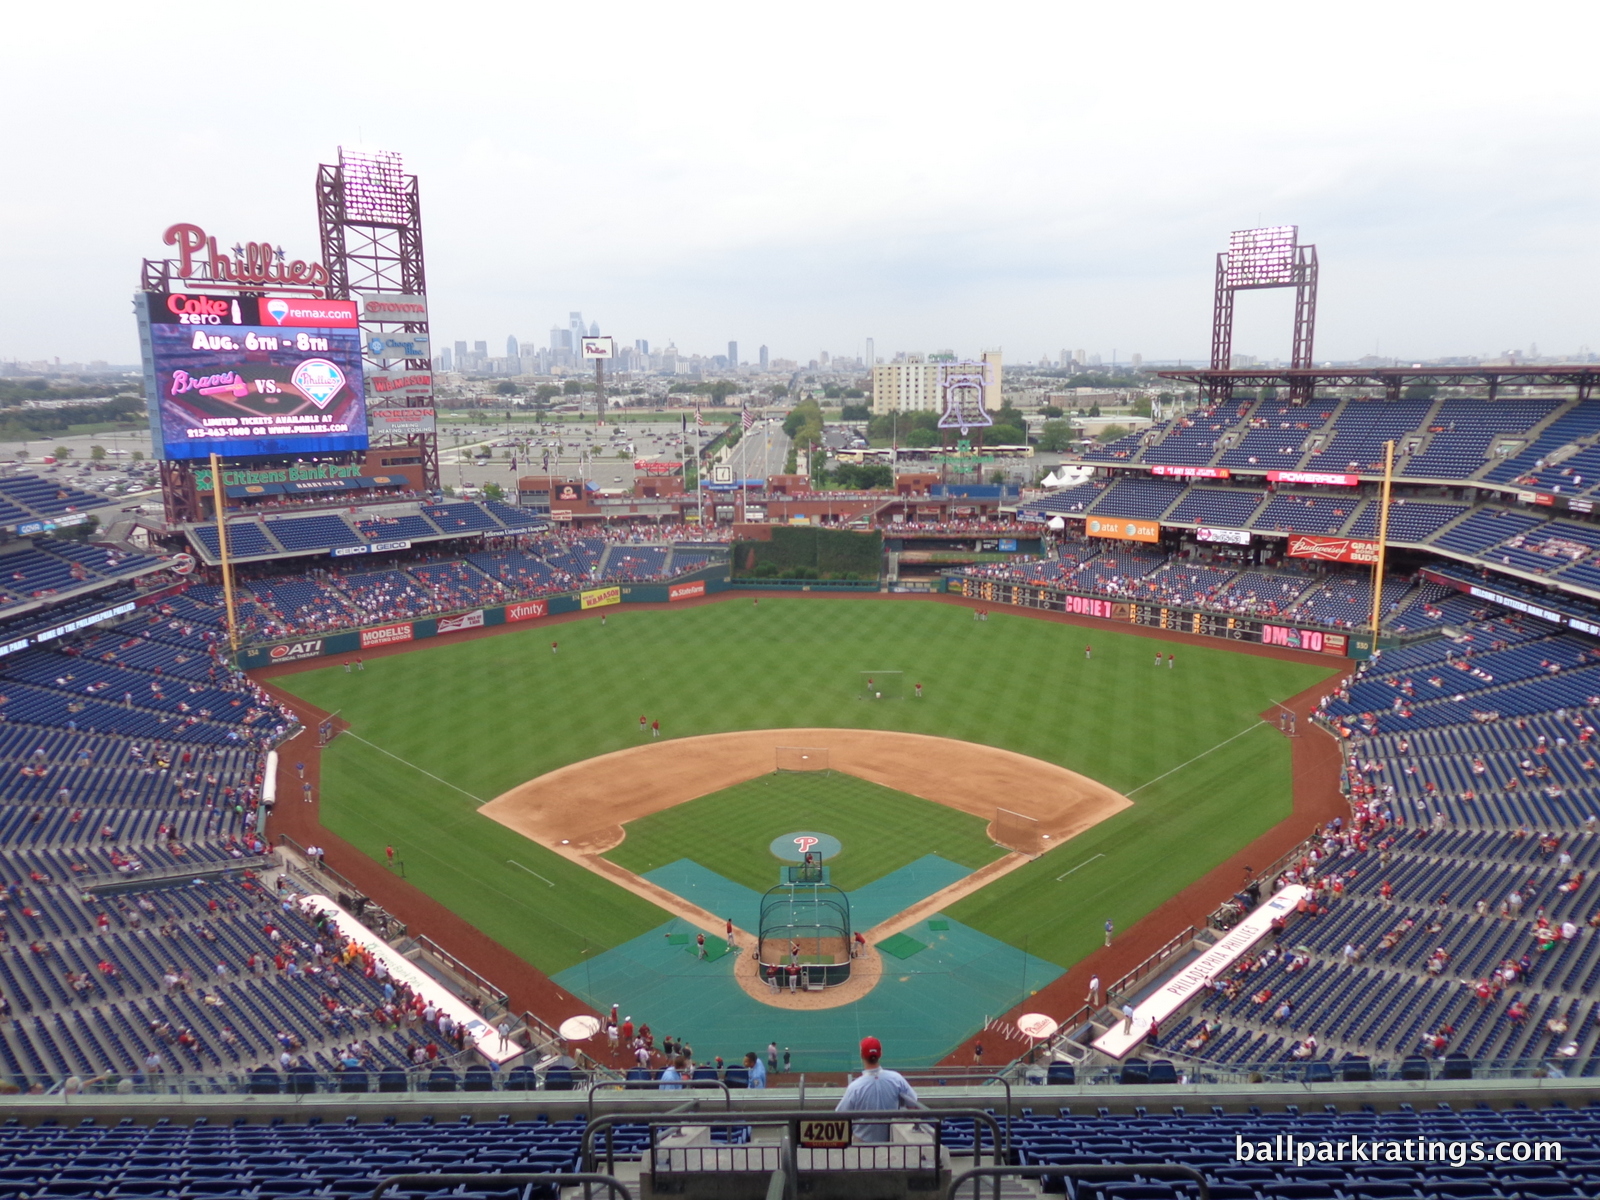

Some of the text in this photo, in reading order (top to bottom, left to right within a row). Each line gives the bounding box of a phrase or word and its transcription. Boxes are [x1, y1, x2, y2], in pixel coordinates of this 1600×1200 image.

[163, 223, 329, 286] Phillies
[167, 294, 228, 316] Coke
[381, 302, 425, 313] TOYOTA
[179, 313, 221, 325] zero
[289, 308, 352, 319] remax.com
[171, 369, 236, 396] Braves
[301, 372, 338, 386] Phillies
[373, 409, 434, 418] HORIZON
[202, 414, 333, 427] LIMITED TICKETS AVAILABLE AT
[252, 426, 266, 436] OR
[222, 462, 362, 486] Citizens Bank Park
[296, 481, 323, 489] HARRY
[1101, 524, 1119, 533] at&t
[1137, 527, 1155, 536] at&t
[335, 546, 367, 556] GEICO
[376, 541, 407, 551] GEICO
[1290, 540, 1347, 554] Budweiser
[1351, 542, 1380, 551] GRAB
[1350, 553, 1379, 562] BUDS
[510, 603, 543, 619] xfinity
[362, 625, 411, 641] MODELL'S
[363, 633, 412, 646] SPORTING GOODS
[287, 640, 322, 656] ATI
[272, 651, 320, 663] PHYSICAL THERAPY
[793, 835, 819, 853] P
[1166, 924, 1260, 996] PHILADELPHIA PHILLIES
[804, 1122, 845, 1141] 420V
